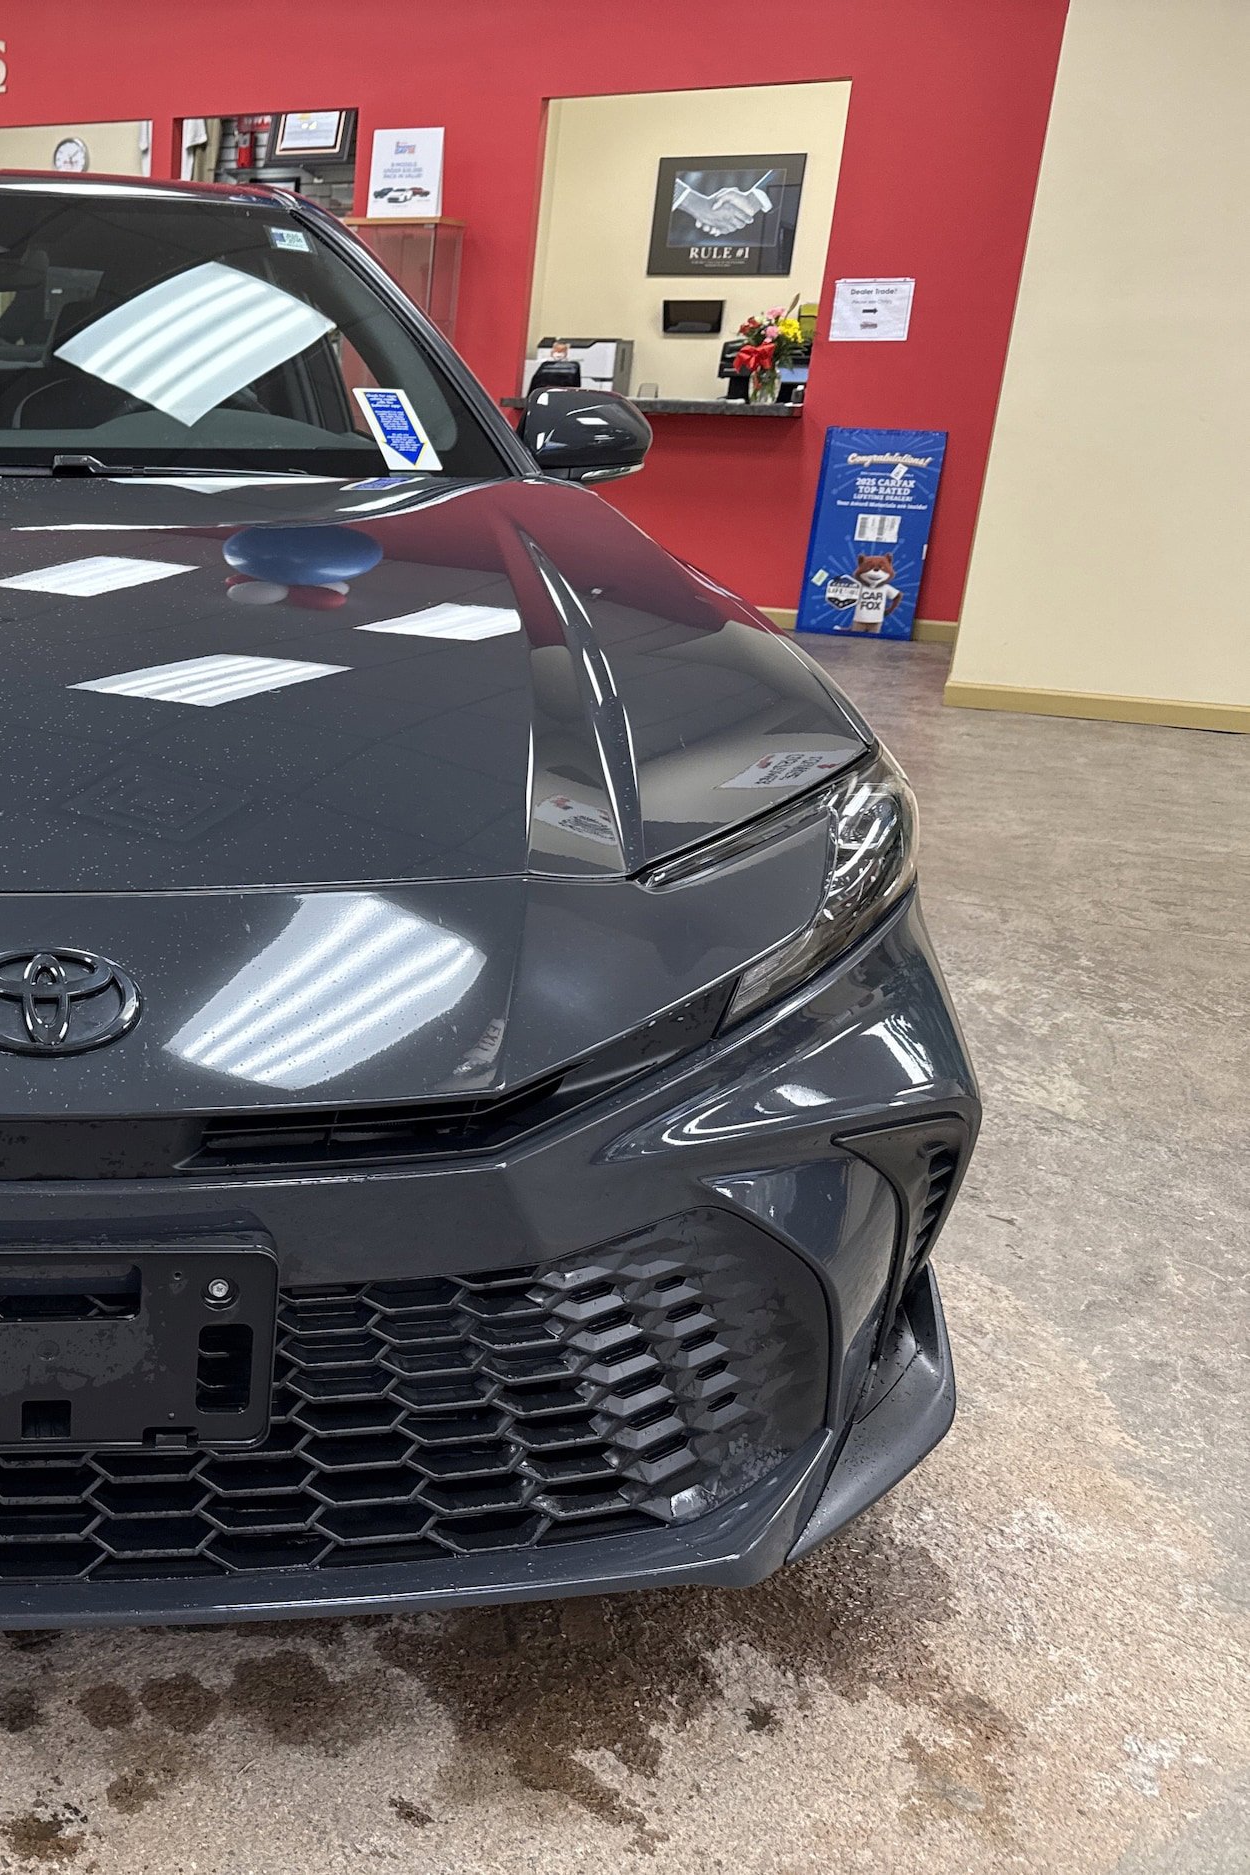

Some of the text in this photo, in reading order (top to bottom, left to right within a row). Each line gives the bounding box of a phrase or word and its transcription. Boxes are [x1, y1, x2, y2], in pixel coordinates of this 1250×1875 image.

[689, 246, 750, 259] RULE #1
[847, 452, 932, 467] Congratulations!
[855, 477, 916, 488] 2025 CARFAX
[858, 485, 910, 496] TOP-RATED
[861, 592, 883, 600] CAR
[860, 601, 881, 610] FOX
